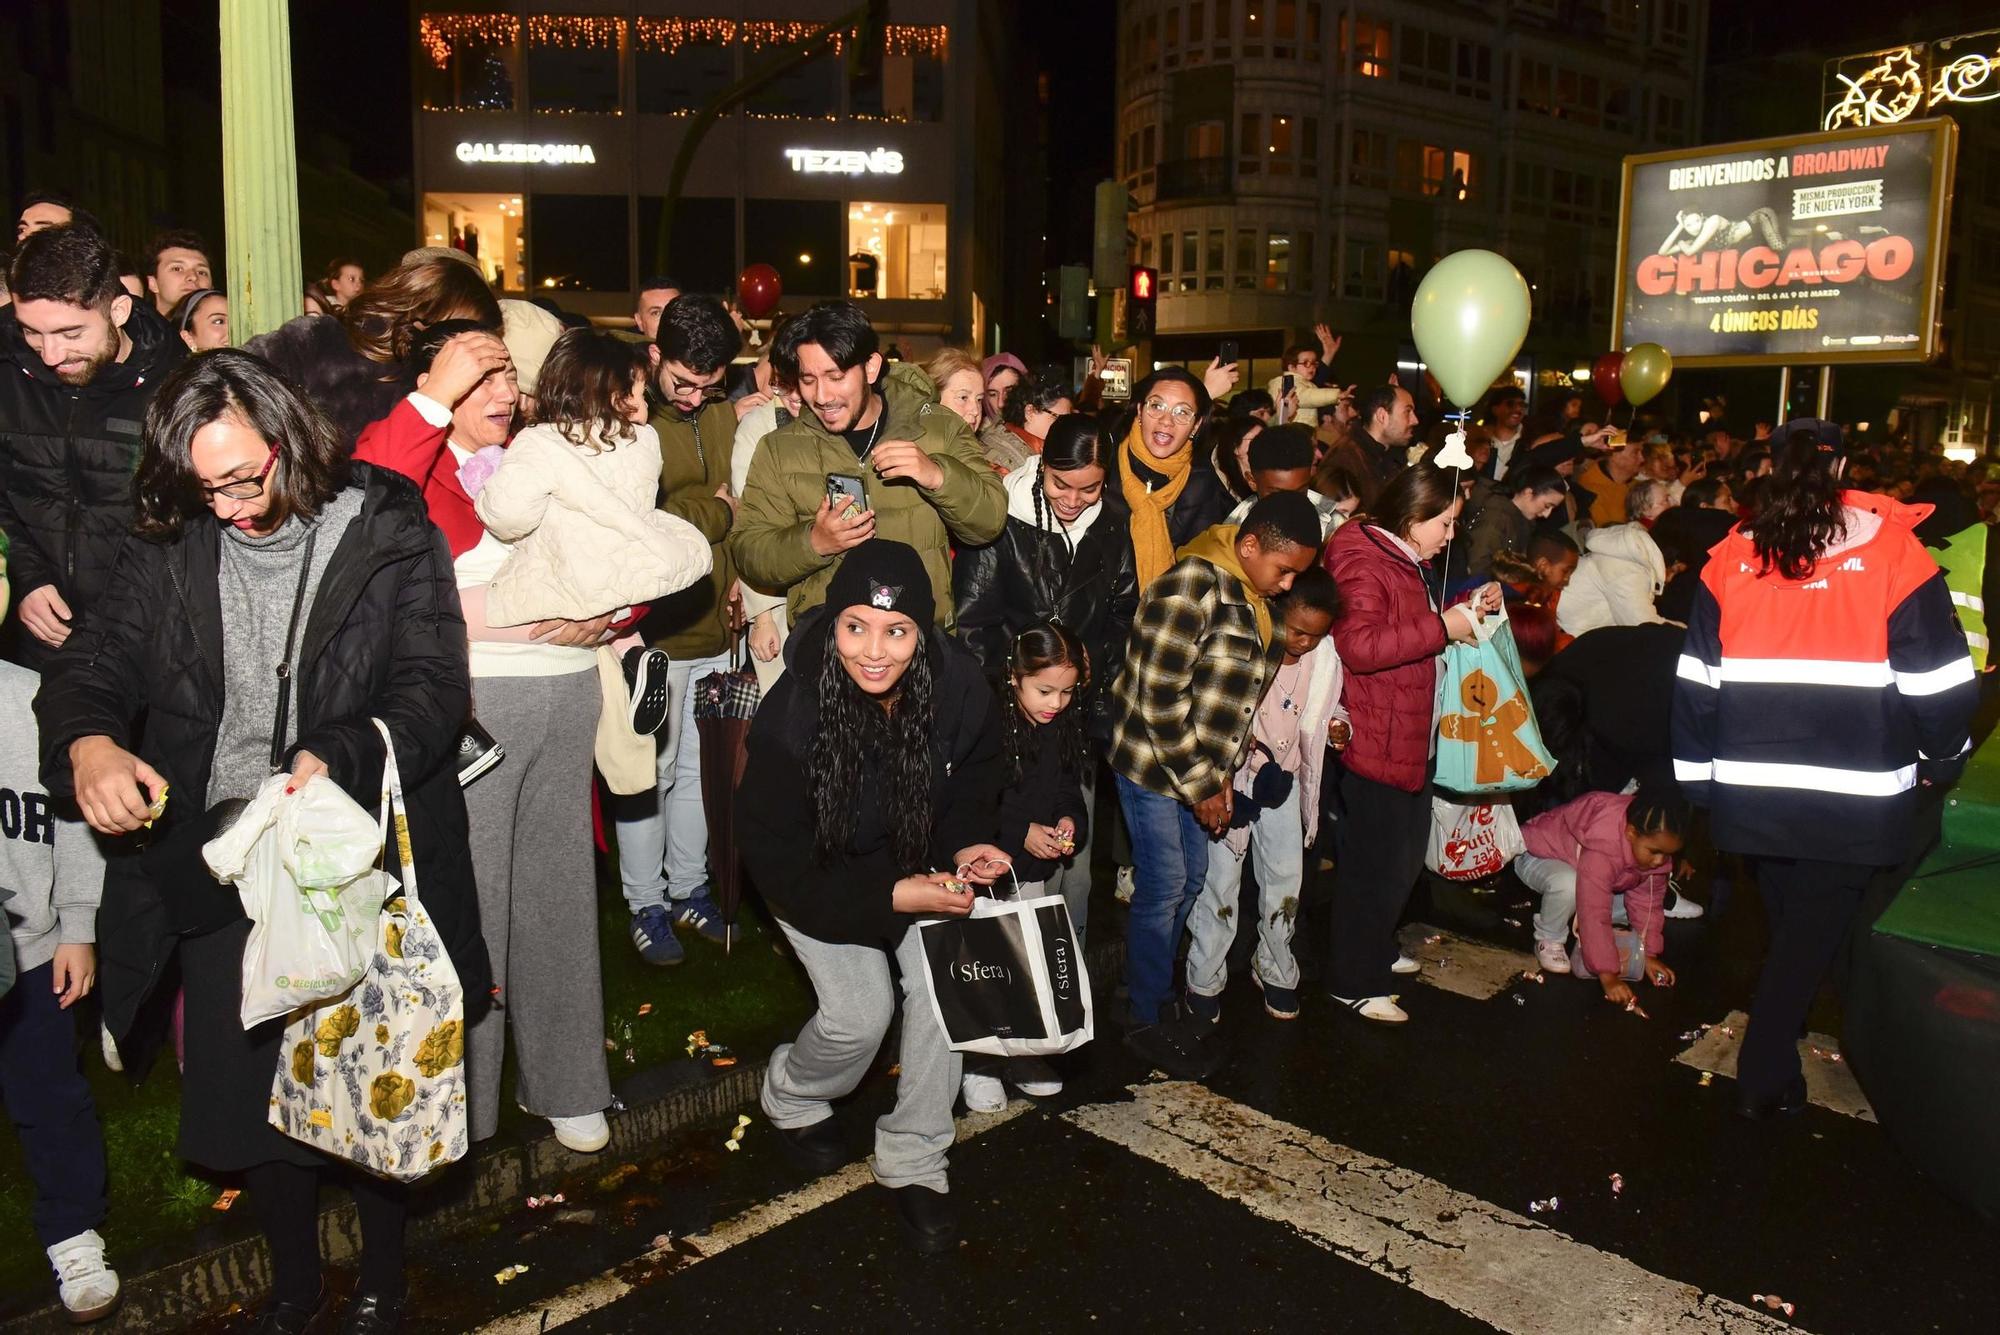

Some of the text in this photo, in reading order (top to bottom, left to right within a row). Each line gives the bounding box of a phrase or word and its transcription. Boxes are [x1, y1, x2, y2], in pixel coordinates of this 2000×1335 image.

[456, 142, 596, 164] CALZEDONIA
[1669, 145, 1890, 190] BIENVENIDOS A BROADWAY
[1800, 184, 1876, 201] MISMA PRODUCCIÓN
[1799, 195, 1875, 214] DE NUEVA YORK
[1637, 235, 1914, 295] CHICAGO
[1694, 296, 1721, 304] TEATRO
[1722, 293, 1749, 303] COLÓN
[1757, 293, 1771, 301] DEL
[1779, 292, 1790, 300] AL
[1798, 291, 1809, 299] DE
[1810, 289, 1840, 298] MARZO
[1709, 304, 1819, 333] 4 ÚNICOS DÍAS
